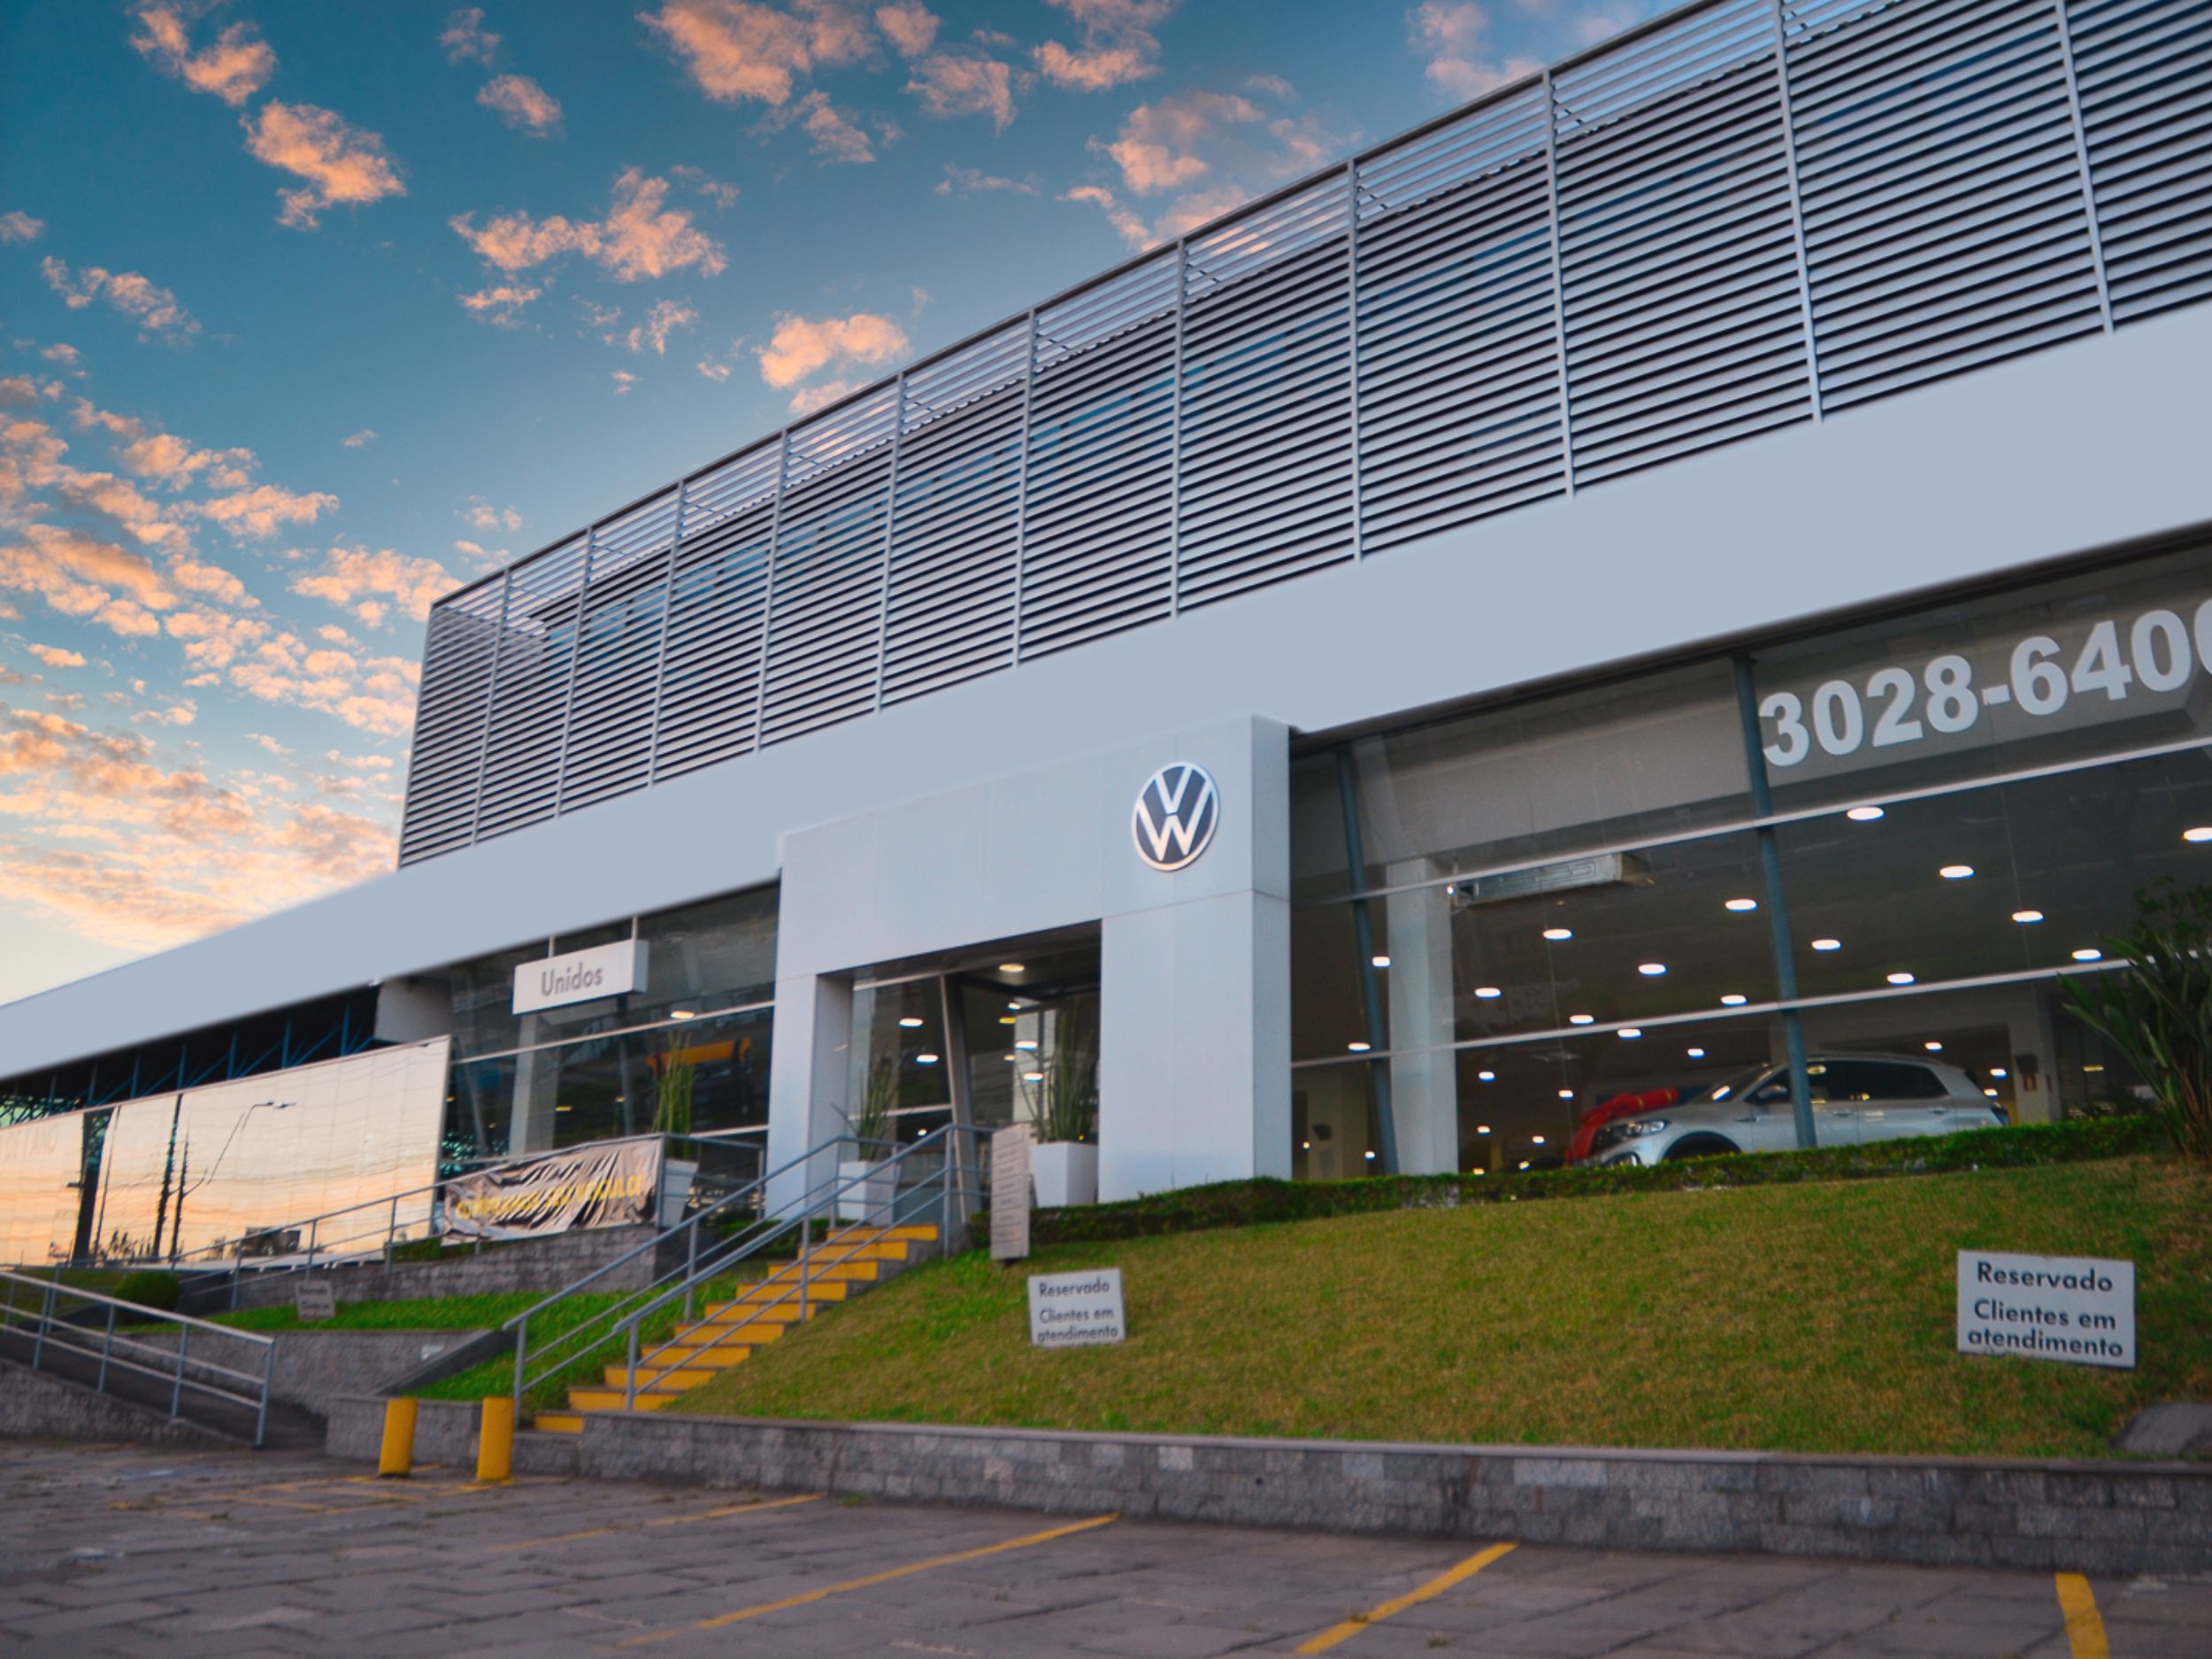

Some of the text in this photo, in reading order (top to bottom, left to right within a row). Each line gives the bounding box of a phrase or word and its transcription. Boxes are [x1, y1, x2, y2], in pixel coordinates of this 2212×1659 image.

[1134, 763, 1216, 864] VW
[541, 961, 603, 997] Unidos
[1039, 1277, 1110, 1297] Reservado
[1977, 1261, 2113, 1293] Reservado
[1039, 1309, 1114, 1324] Clientes em
[1974, 1298, 2116, 1330] Clientes em
[1037, 1325, 1119, 1343] atendimento
[1968, 1328, 2124, 1358] atendimento
